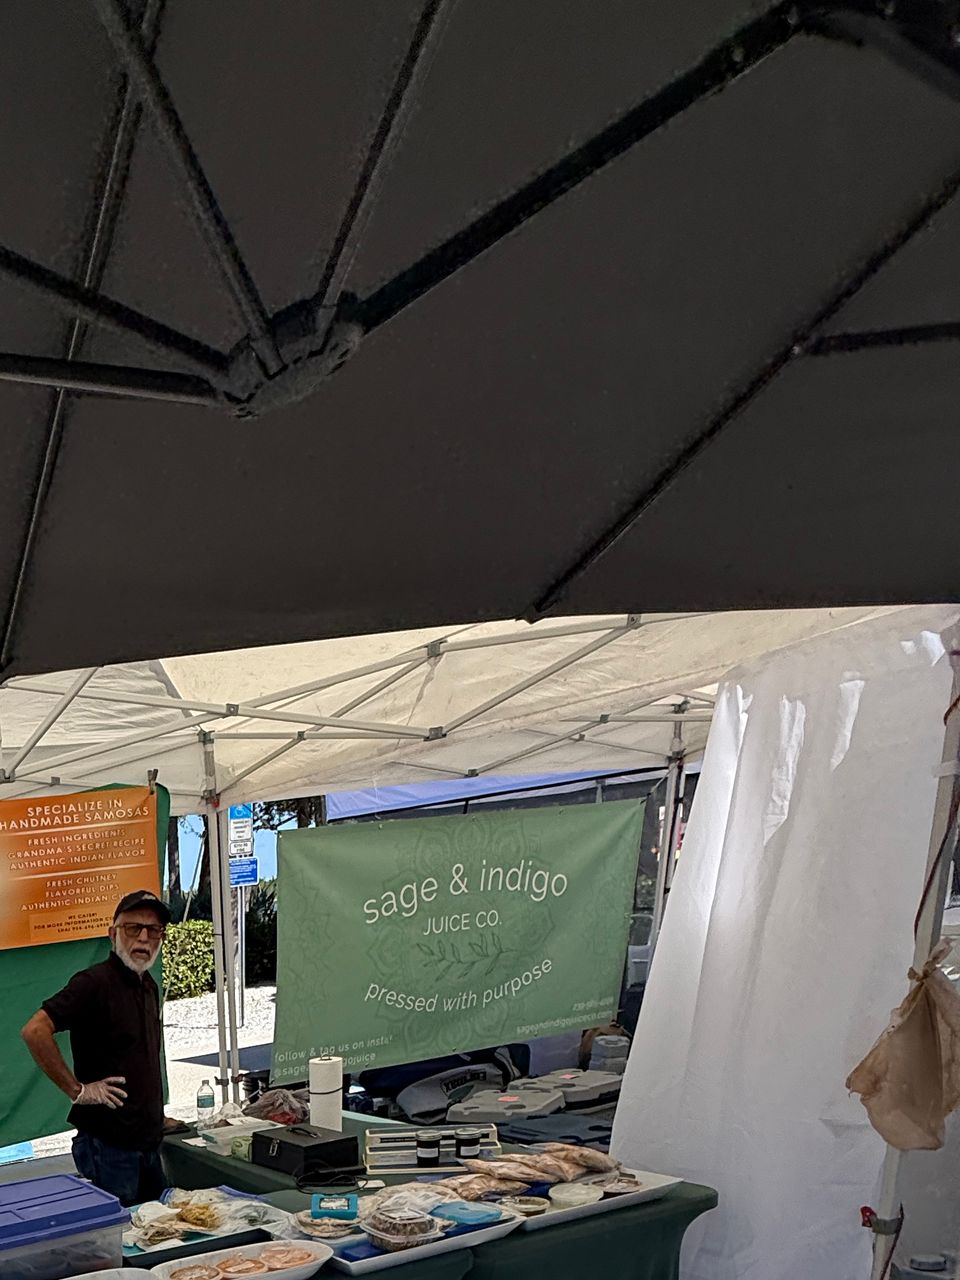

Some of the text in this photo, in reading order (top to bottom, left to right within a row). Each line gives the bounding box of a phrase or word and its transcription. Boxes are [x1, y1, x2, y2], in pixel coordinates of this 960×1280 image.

[0, 806, 149, 831] HANDMADE SAMOSAS
[27, 799, 123, 817] SPECIALIZE IN
[8, 837, 145, 859] GRANDMA'S SECRET RECIPE
[28, 829, 126, 846] FRESH INGREDIENTS
[10, 849, 146, 870] AUTHENTIC INDIAN FLAVOR
[45, 883, 119, 898] FLAVORFUL DIPS
[46, 873, 117, 888] FRESH CHUTNEY
[363, 859, 568, 923] sage & indigo
[20, 899, 71, 911] AUTHENTIC
[74, 896, 107, 905] INDIAN
[64, 917, 104, 927] INFORMATION
[423, 910, 502, 936] JUICE CO.
[365, 982, 439, 1013] pressed
[443, 990, 477, 1012] with
[482, 958, 553, 1006] purpose
[275, 1050, 306, 1063] follow
[309, 1047, 316, 1056] &
[320, 1045, 335, 1057] tag
[338, 1043, 350, 1052] us
[352, 1041, 365, 1050] on
